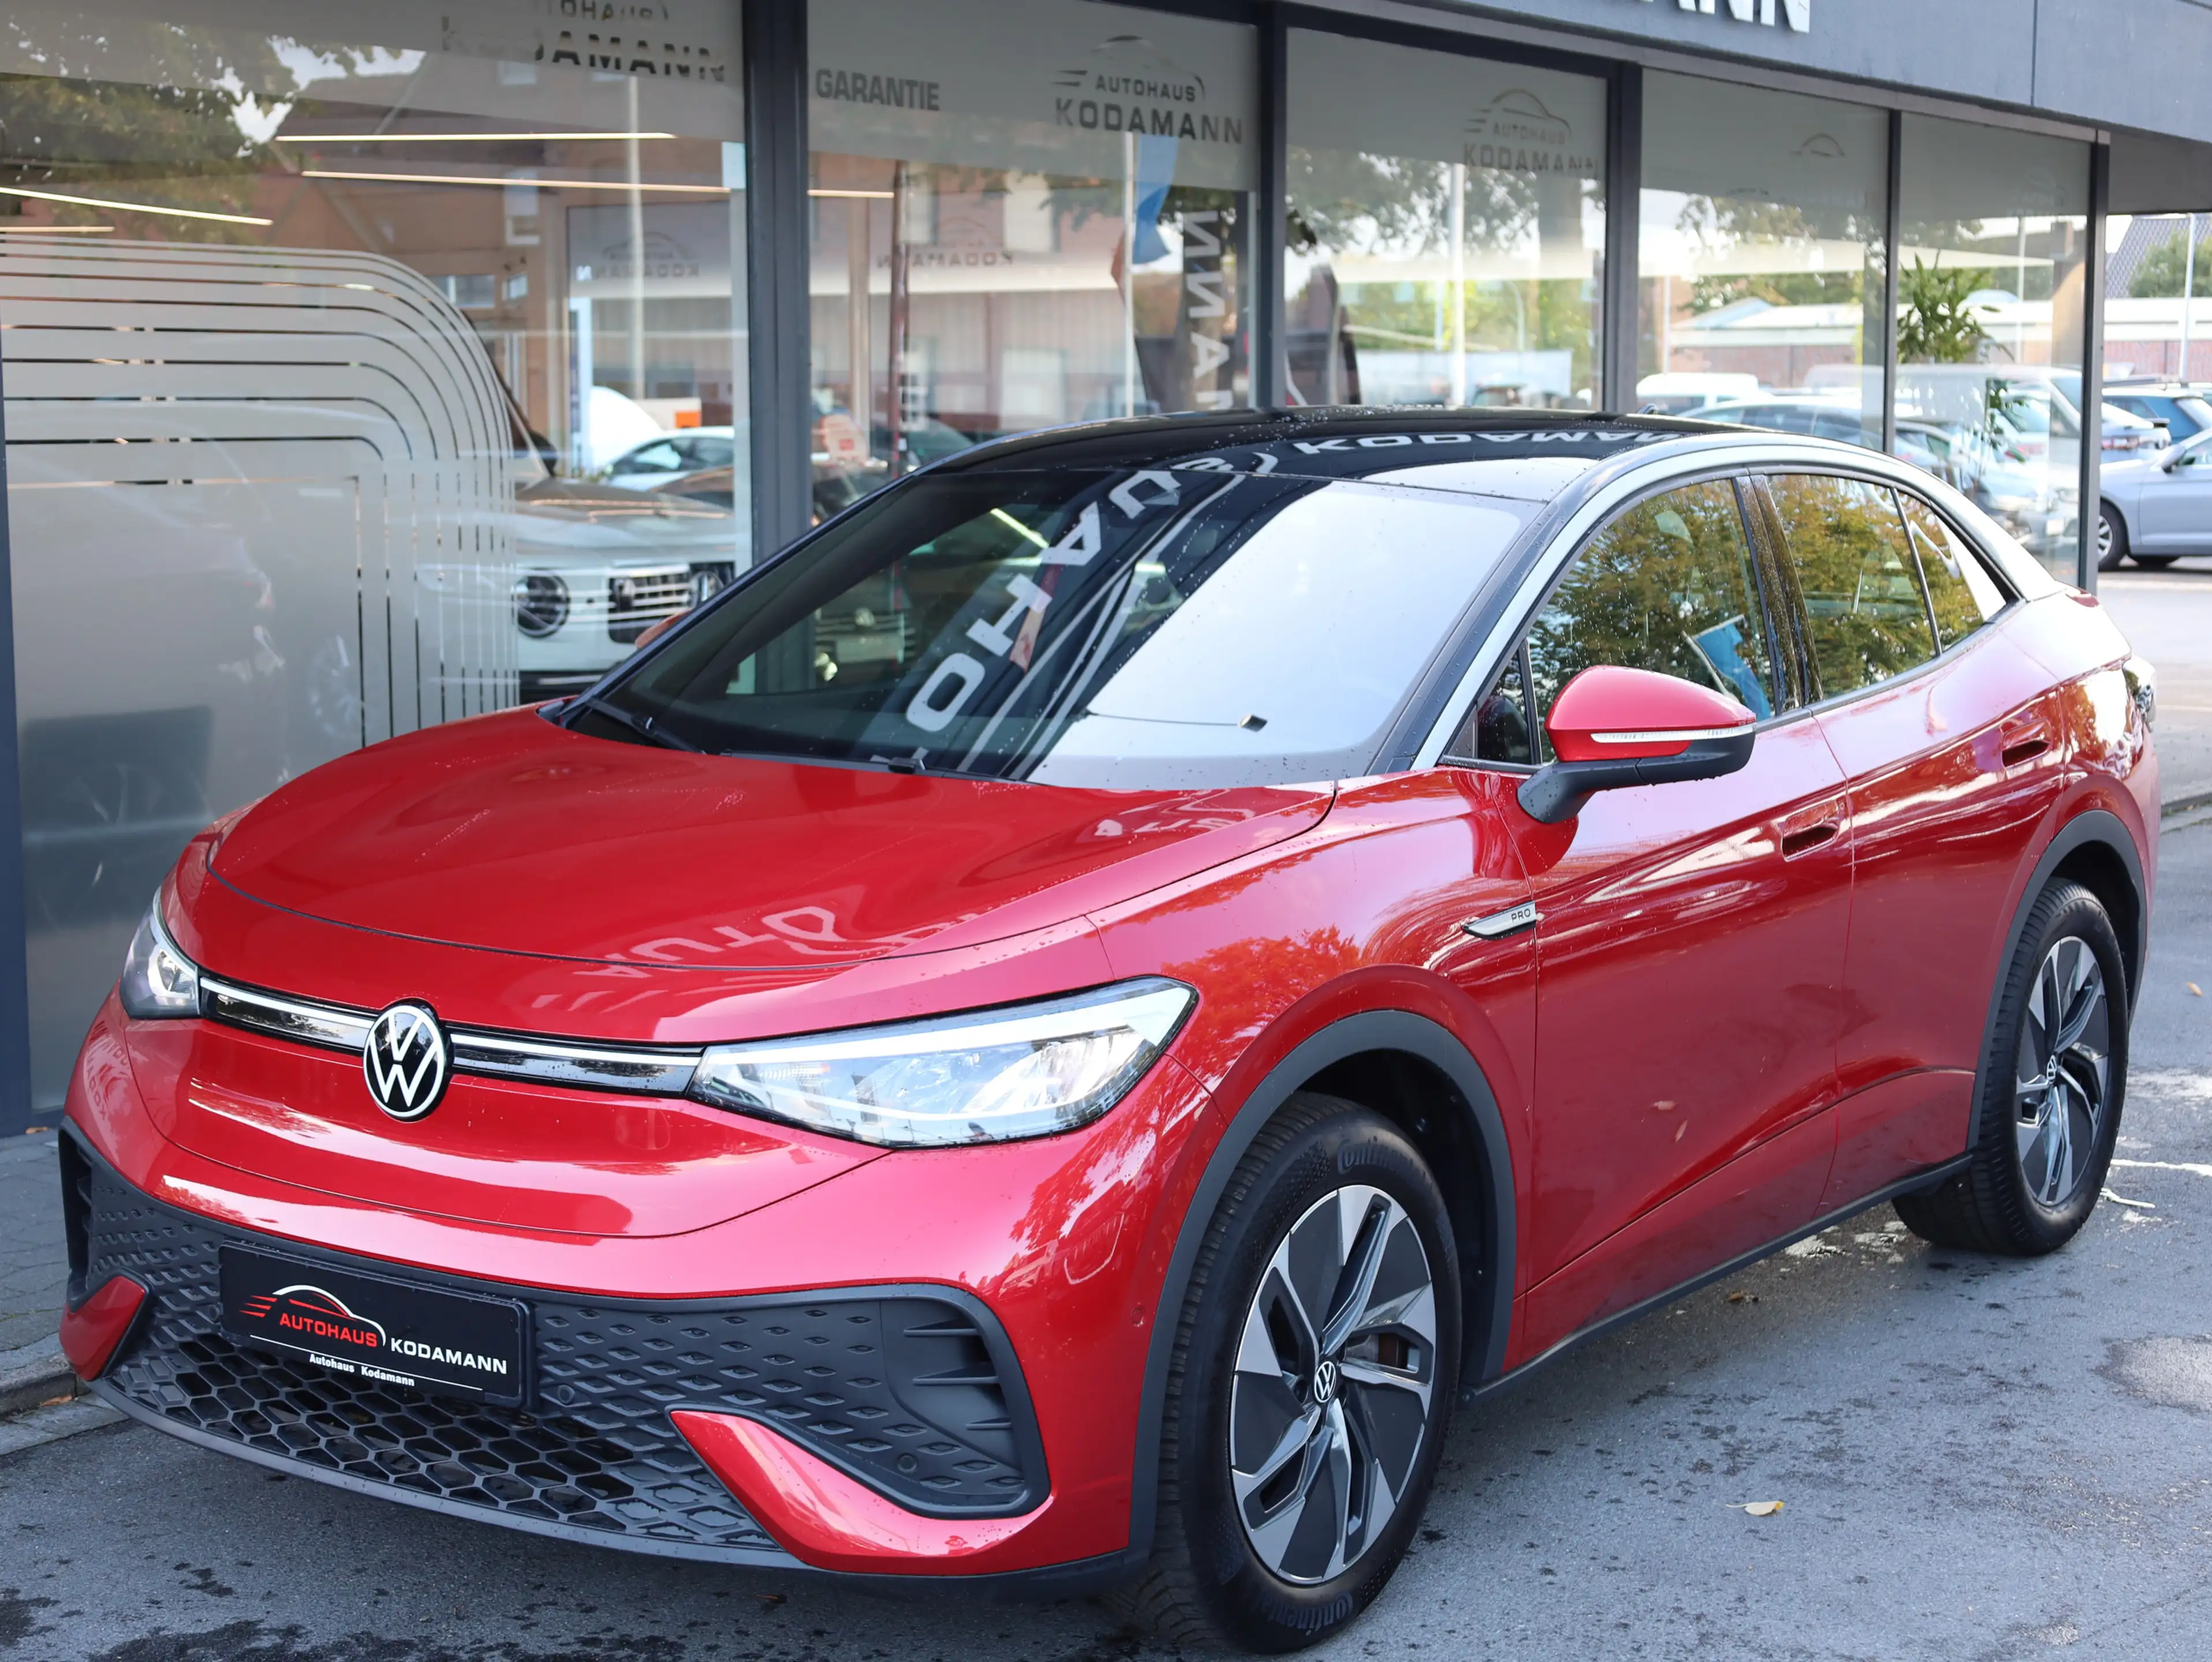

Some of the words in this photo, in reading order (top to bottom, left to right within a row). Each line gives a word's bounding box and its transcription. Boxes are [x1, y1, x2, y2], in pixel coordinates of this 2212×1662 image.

[816, 68, 940, 111] GARANTIE
[1095, 74, 1196, 103] AUTOHAUS
[1055, 97, 1242, 144] KODAMANN
[1511, 908, 1531, 920] PRO
[279, 1313, 378, 1347] AUTOHAUS
[391, 1338, 507, 1374] KODAMANN
[309, 1354, 354, 1373] Autohaus
[361, 1365, 414, 1386] Kodamann
